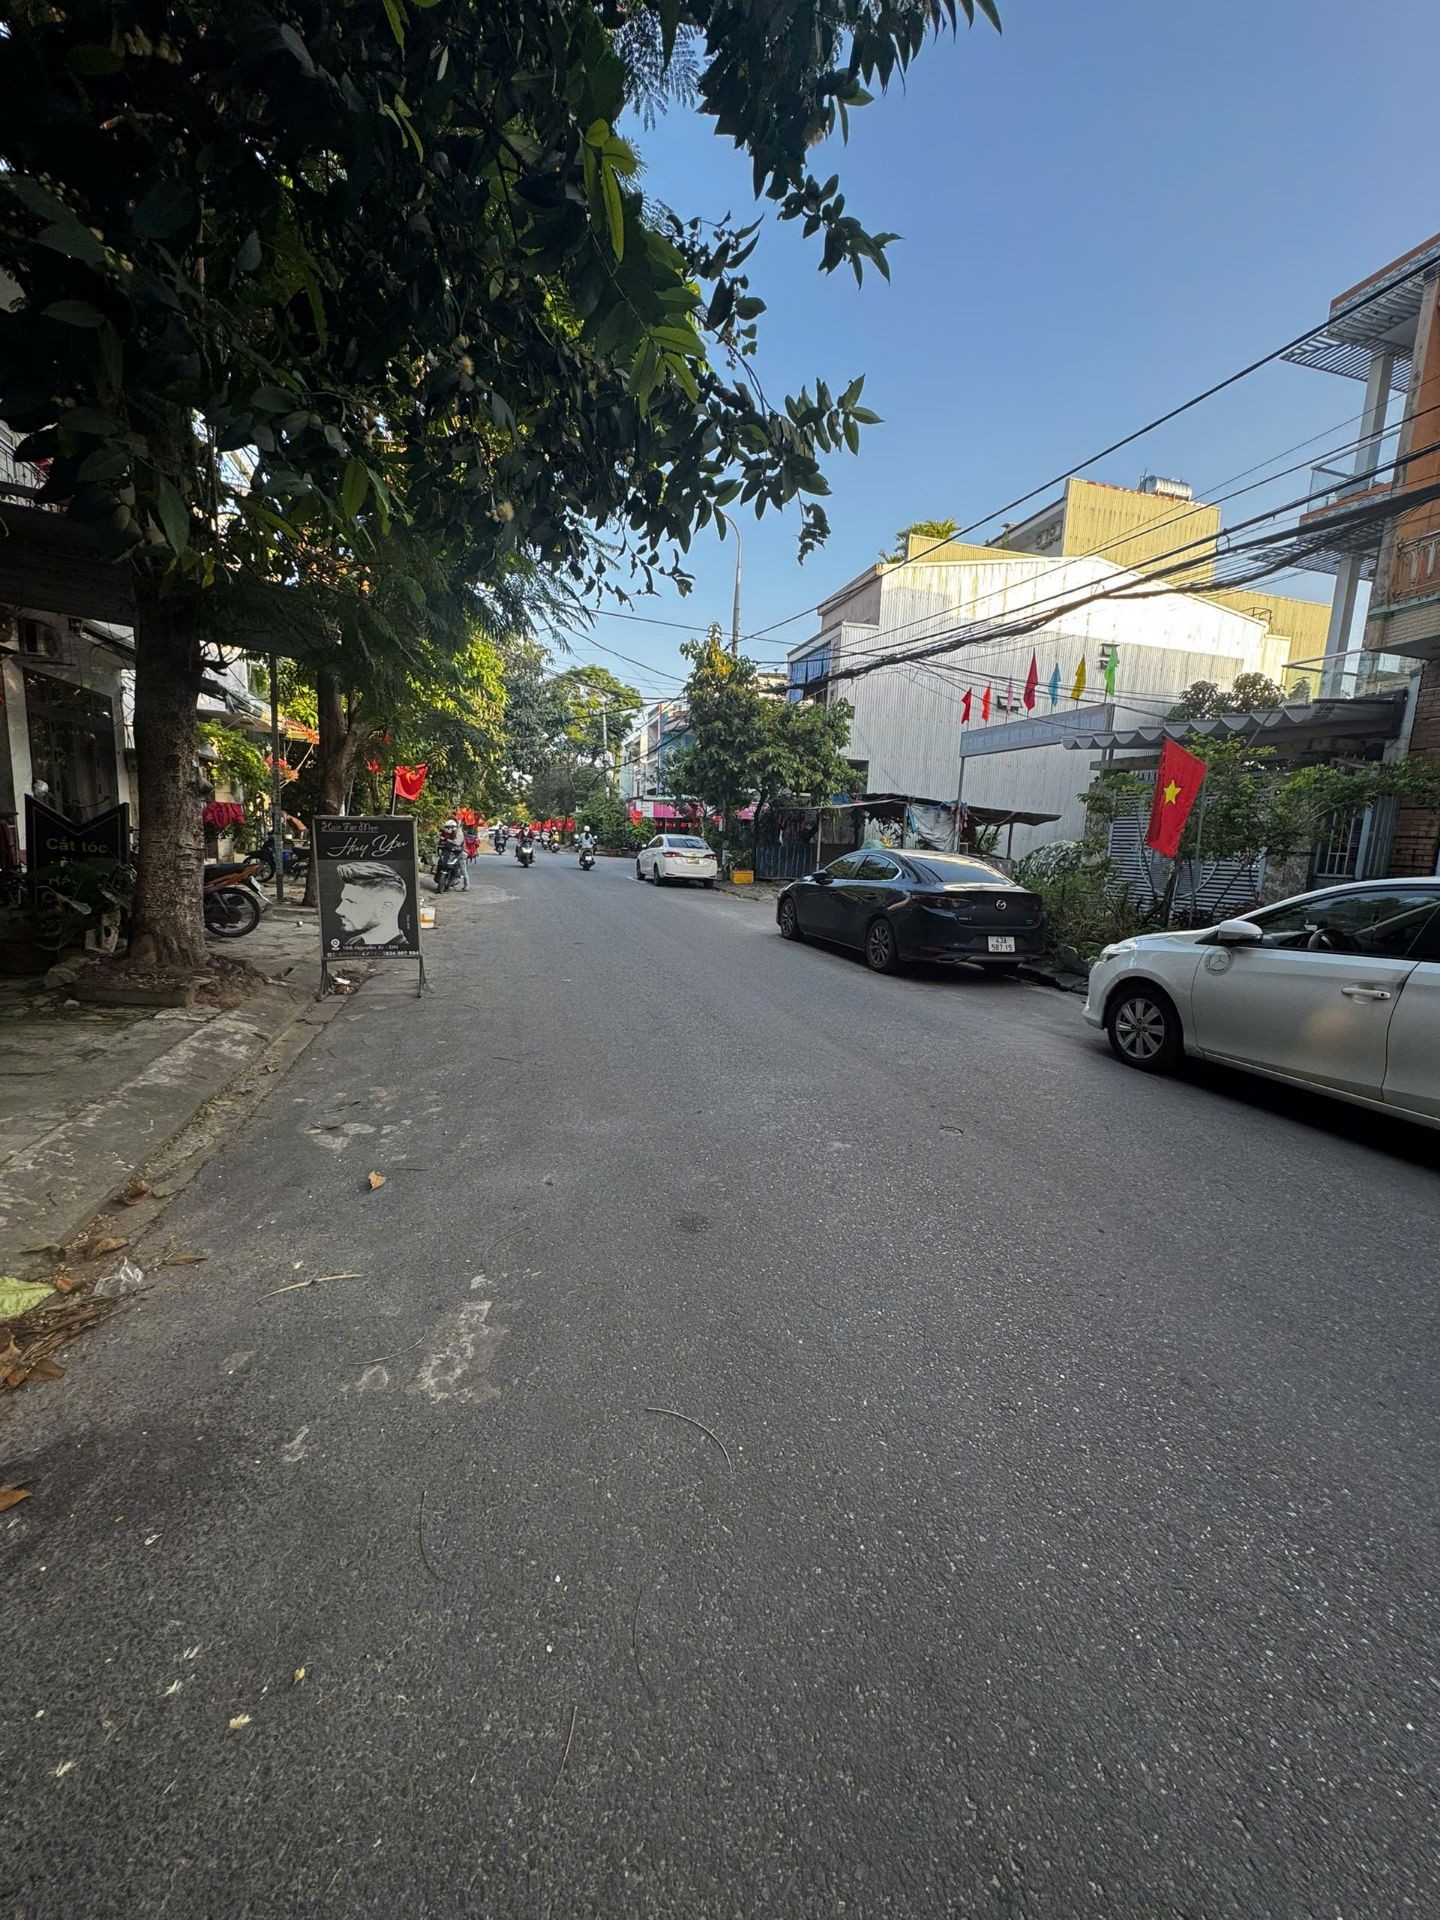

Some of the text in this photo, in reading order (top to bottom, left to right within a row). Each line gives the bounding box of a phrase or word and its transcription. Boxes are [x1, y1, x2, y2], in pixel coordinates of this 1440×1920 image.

[358, 822, 379, 831] Men
[46, 836, 108, 854] Cắt tóc
[996, 936, 1007, 944] 43A
